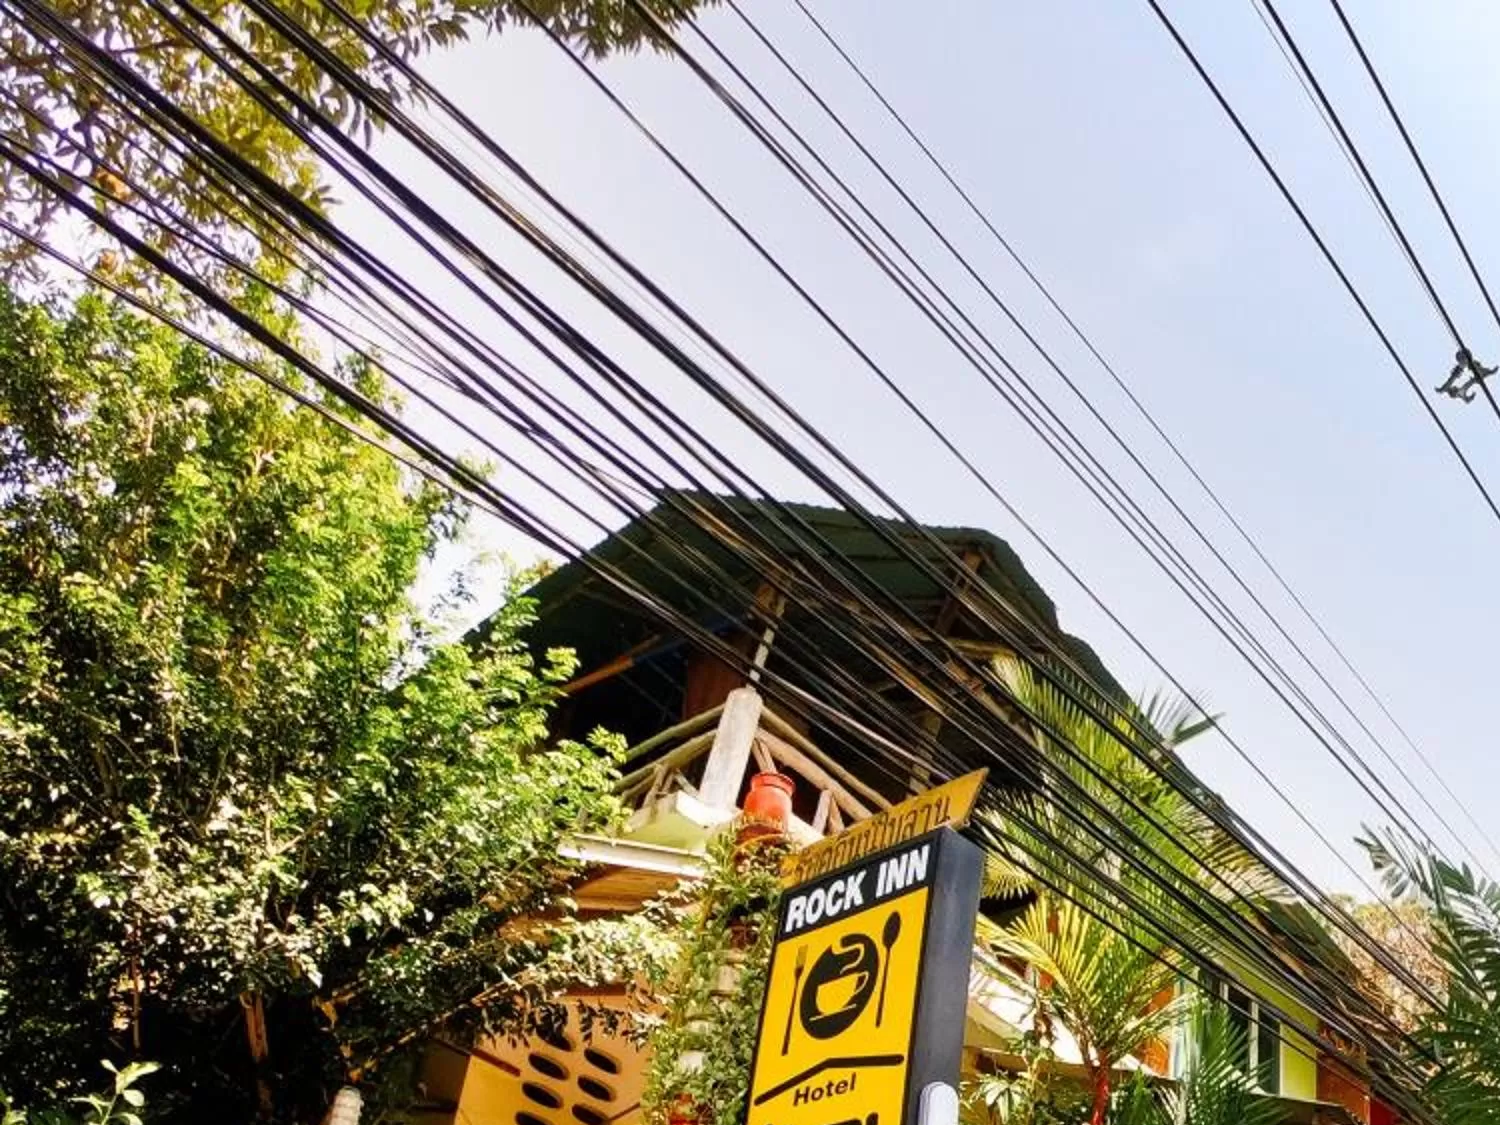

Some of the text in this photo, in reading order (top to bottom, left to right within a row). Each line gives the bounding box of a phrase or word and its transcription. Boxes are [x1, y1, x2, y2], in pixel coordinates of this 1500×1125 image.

[785, 844, 930, 933] ROCK INN
[793, 1072, 856, 1107] Hotel
